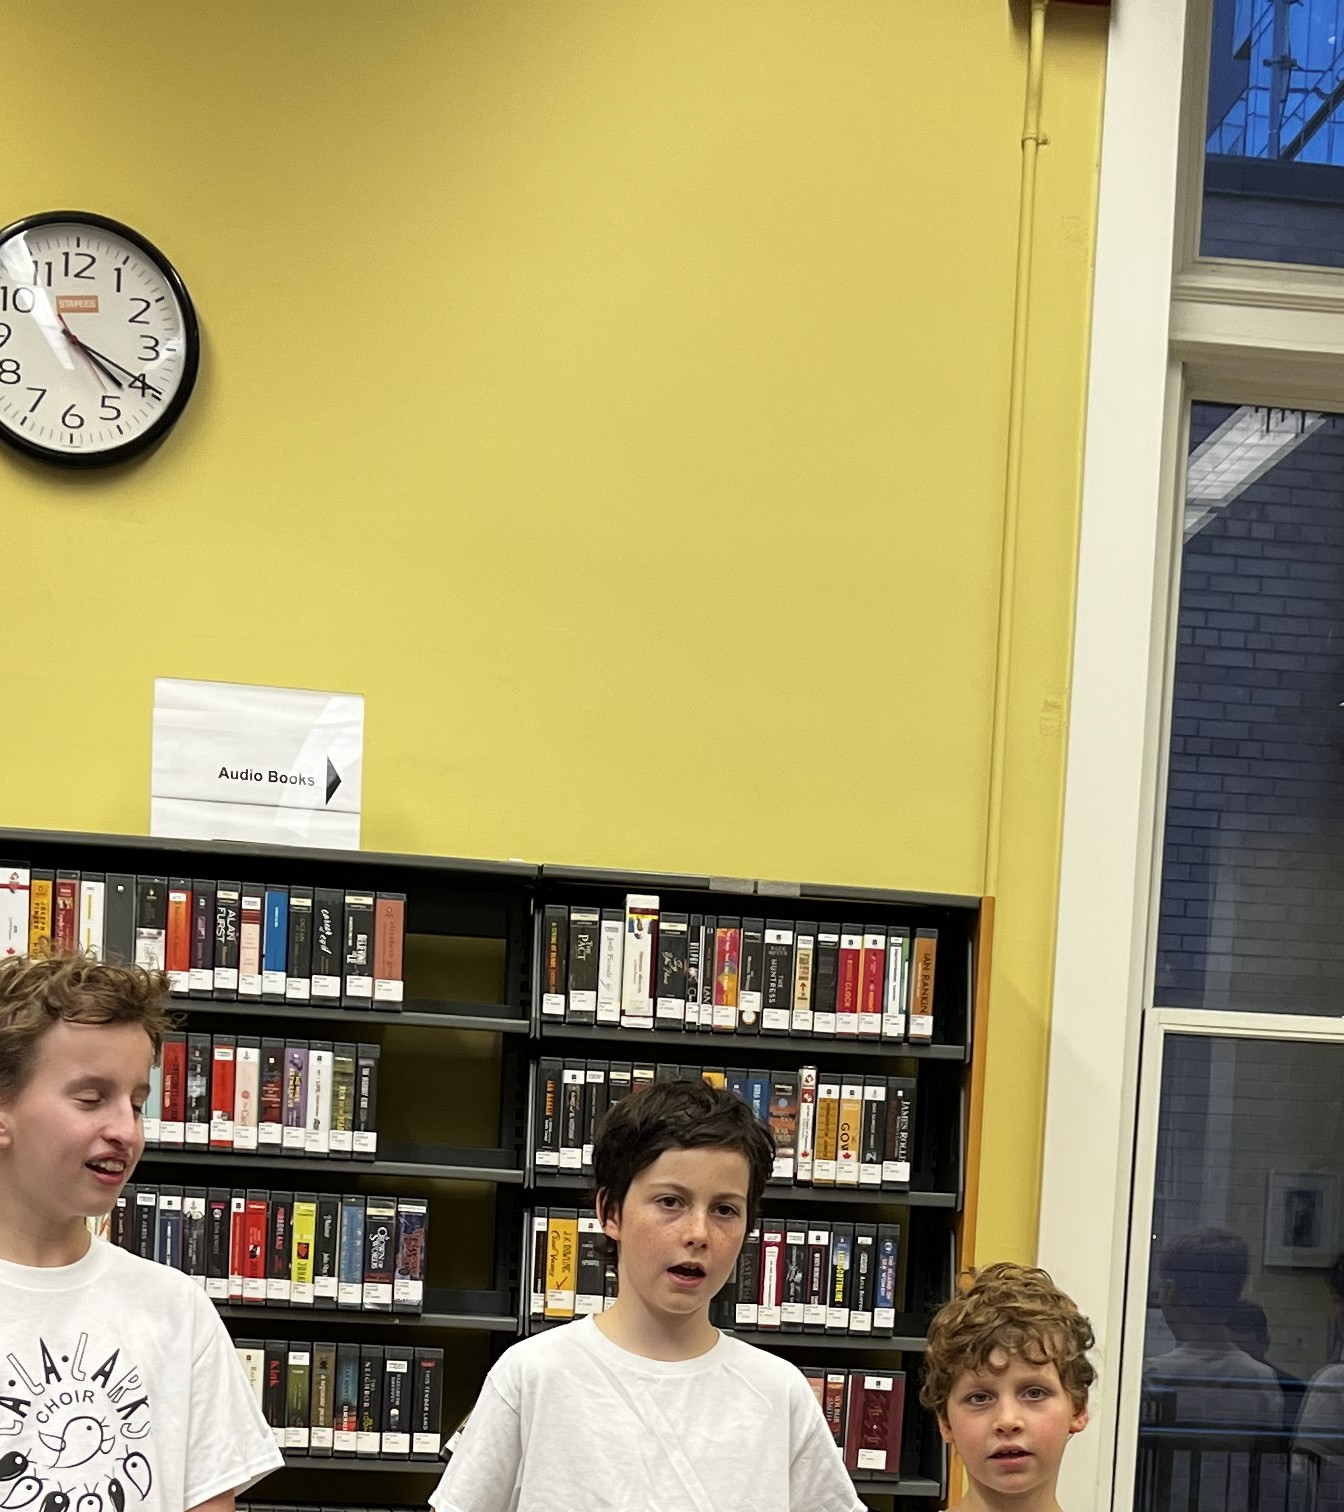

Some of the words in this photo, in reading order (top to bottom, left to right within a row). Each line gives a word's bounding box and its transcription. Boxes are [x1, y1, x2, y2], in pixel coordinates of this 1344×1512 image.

[32, 260, 52, 287] 11
[62, 252, 96, 279] 12
[114, 267, 122, 293] 1
[0, 285, 35, 313] 10
[128, 298, 151, 324] 2
[138, 335, 160, 361] 3
[128, 373, 153, 398] 4
[25, 387, 46, 413] 7
[99, 395, 121, 421] 5
[61, 404, 84, 429] 6
[218, 767, 263, 782] Audio
[268, 770, 315, 786] Books
[216, 907, 225, 943] FURST
[227, 908, 237, 942] ALAN
[577, 934, 588, 961] PACT
[769, 958, 777, 1004] HUNTRESS
[920, 975, 930, 1014] RANKIN
[900, 1100, 910, 1129] JAMES
[363, 1361, 371, 1408] NEIGHBOR
[36, 1390, 95, 1424] CHOIR
